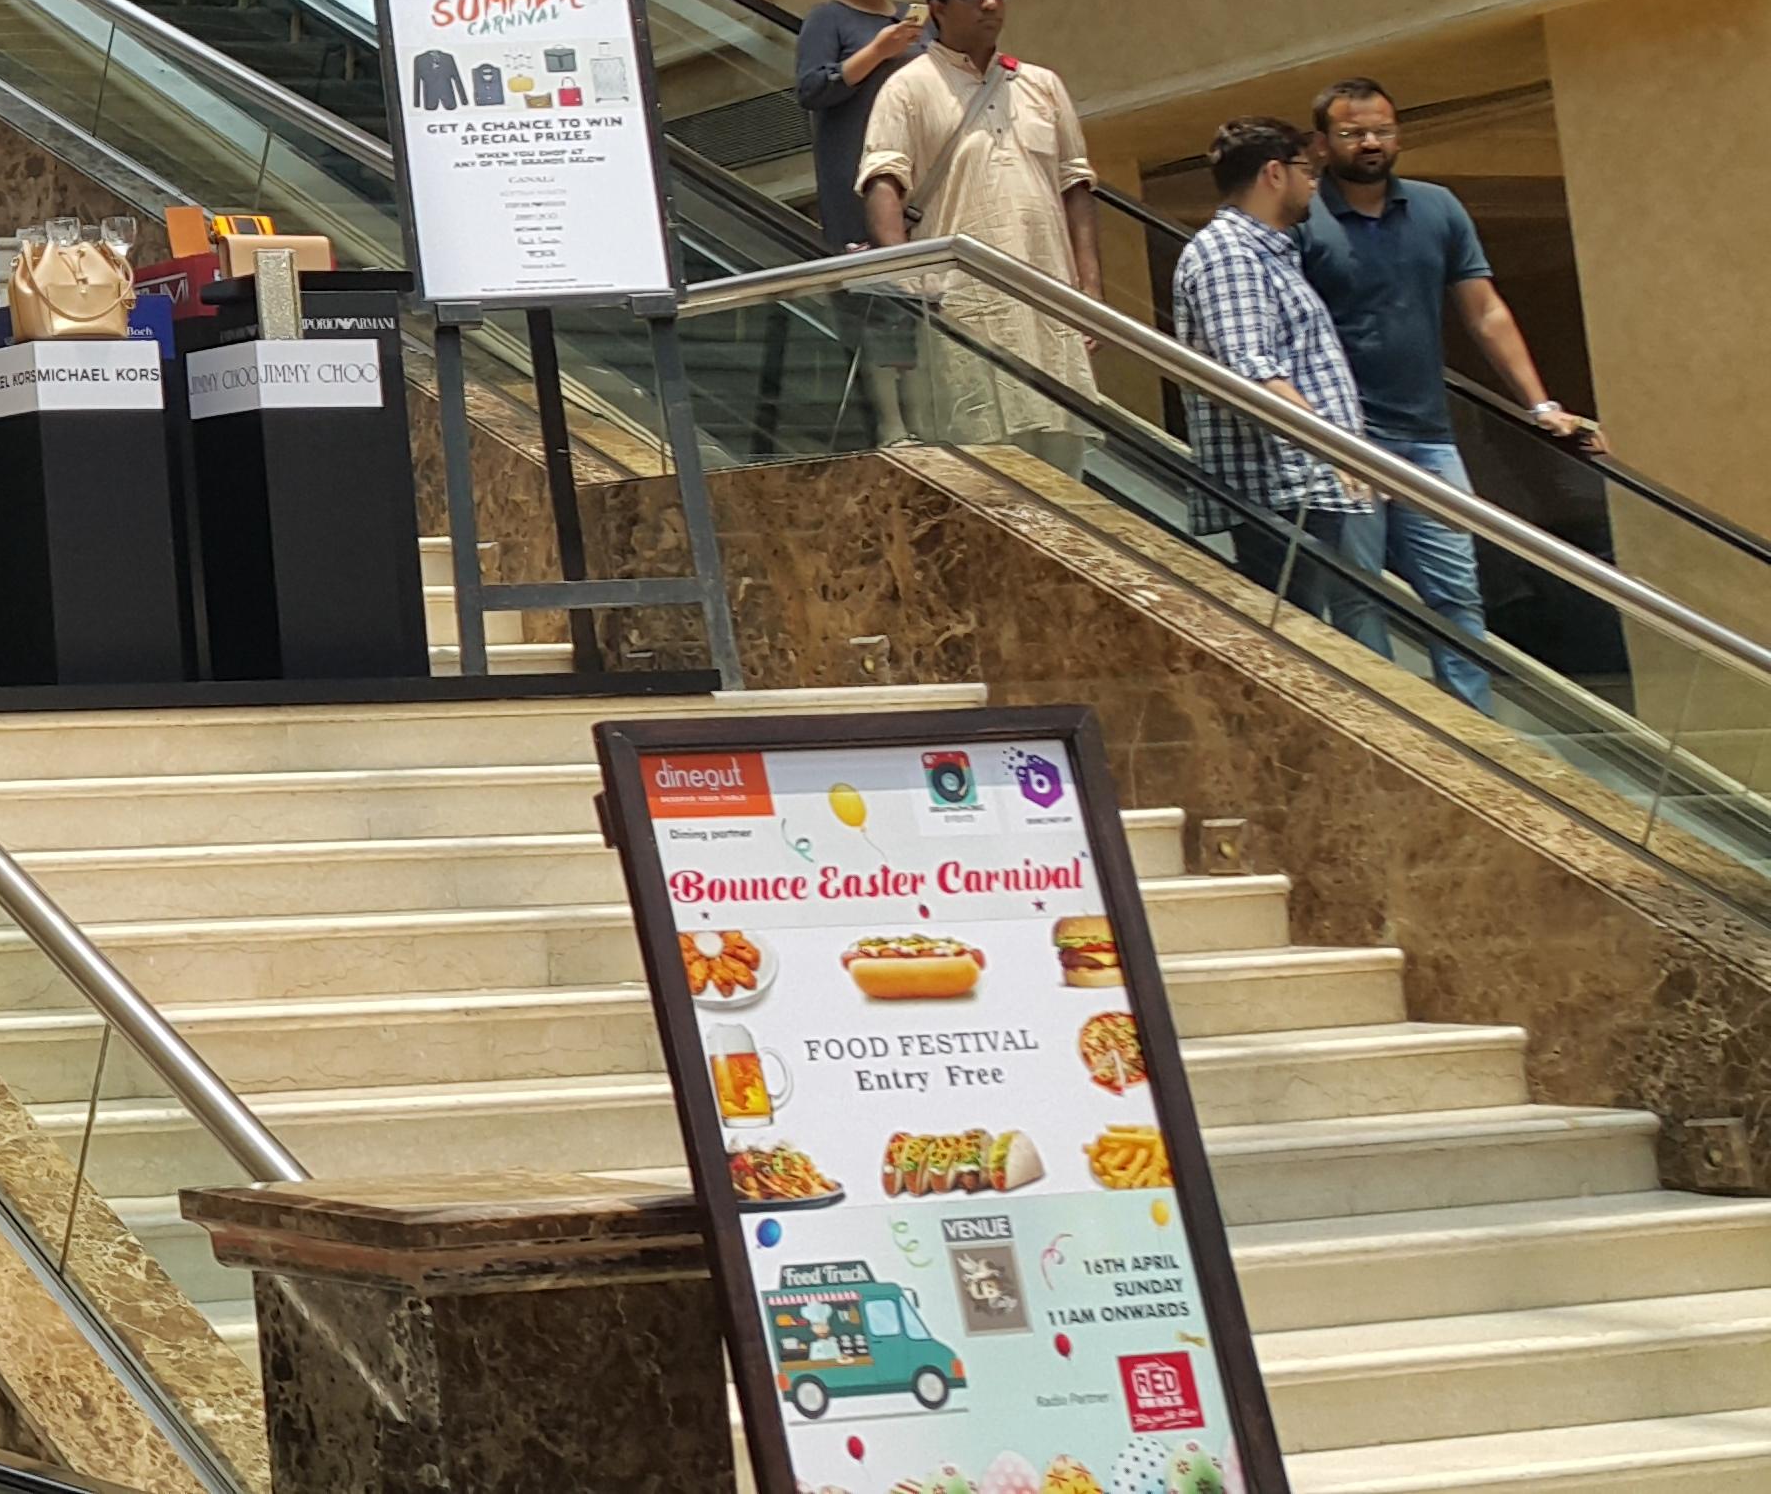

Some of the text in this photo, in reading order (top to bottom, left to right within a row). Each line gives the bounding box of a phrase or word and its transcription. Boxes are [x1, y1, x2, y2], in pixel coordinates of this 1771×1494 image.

[467, 4, 560, 35] CARNIVAL
[427, 116, 623, 134] GET A CHANCE TO WIN
[461, 130, 592, 146] SPECIAL PRIZES
[12, 369, 36, 386] KORS
[37, 367, 161, 382] MICHAEL KORS
[190, 365, 258, 396] JIMMY CHOO
[259, 362, 379, 384] JIMMY CHOO
[655, 757, 745, 790] dineout
[669, 828, 753, 841] Dining partner
[668, 858, 1082, 904] Bounce Easter Carnival
[803, 1029, 1039, 1061] FOOD FESTIVAL
[854, 1065, 1006, 1093] Entry Free
[944, 1217, 1012, 1238] VENUE
[783, 1264, 870, 1286] Food Truck
[1083, 1254, 1180, 1275] 16TH APRIL
[1114, 1278, 1184, 1297] SUNDAY
[1046, 1302, 1190, 1326] 11AM ONWARDS
